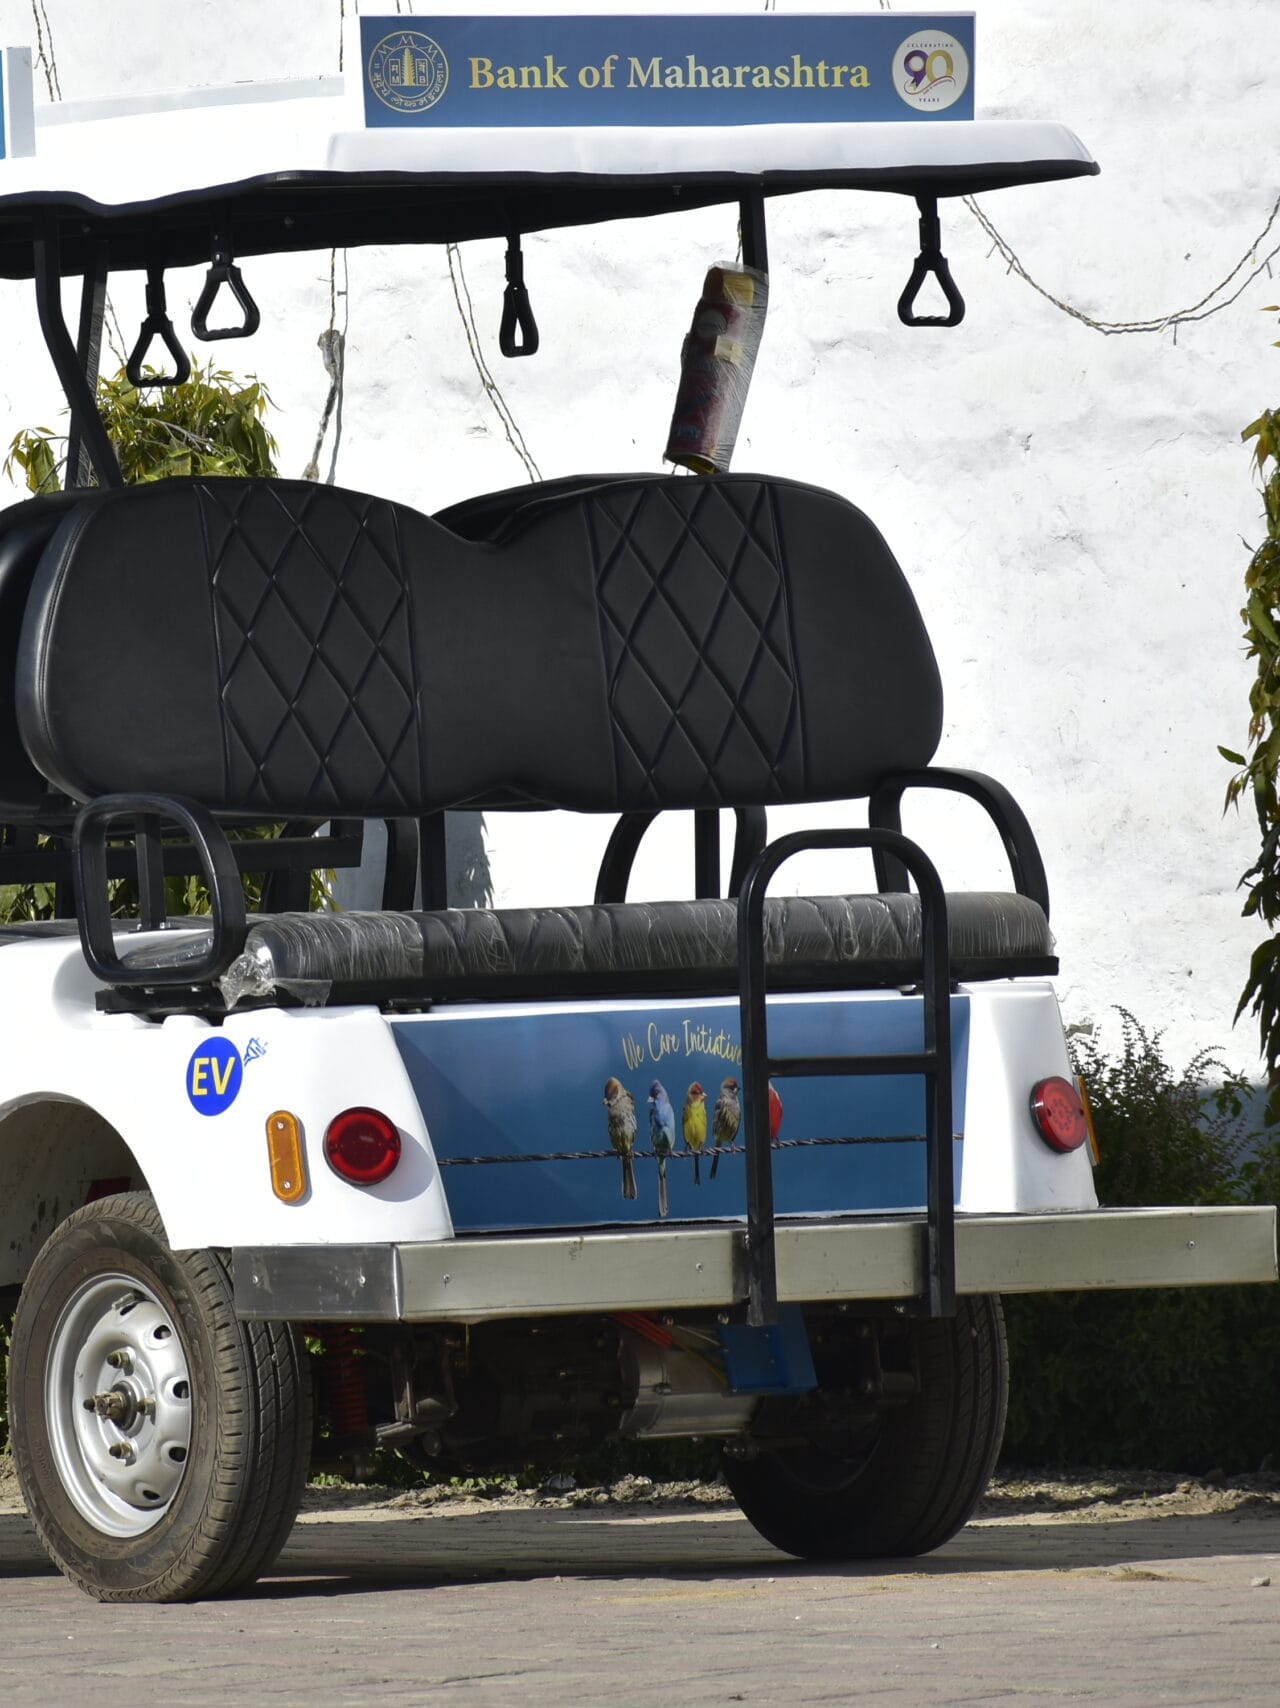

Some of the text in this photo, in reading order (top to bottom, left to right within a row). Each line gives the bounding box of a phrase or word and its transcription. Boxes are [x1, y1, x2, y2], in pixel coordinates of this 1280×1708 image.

[468, 55, 569, 89] Bank
[578, 54, 620, 88] of
[626, 55, 871, 89] Maharashtra
[904, 50, 954, 88] 90
[622, 1019, 743, 1071] We Care Initiative
[192, 1056, 237, 1096] EV
